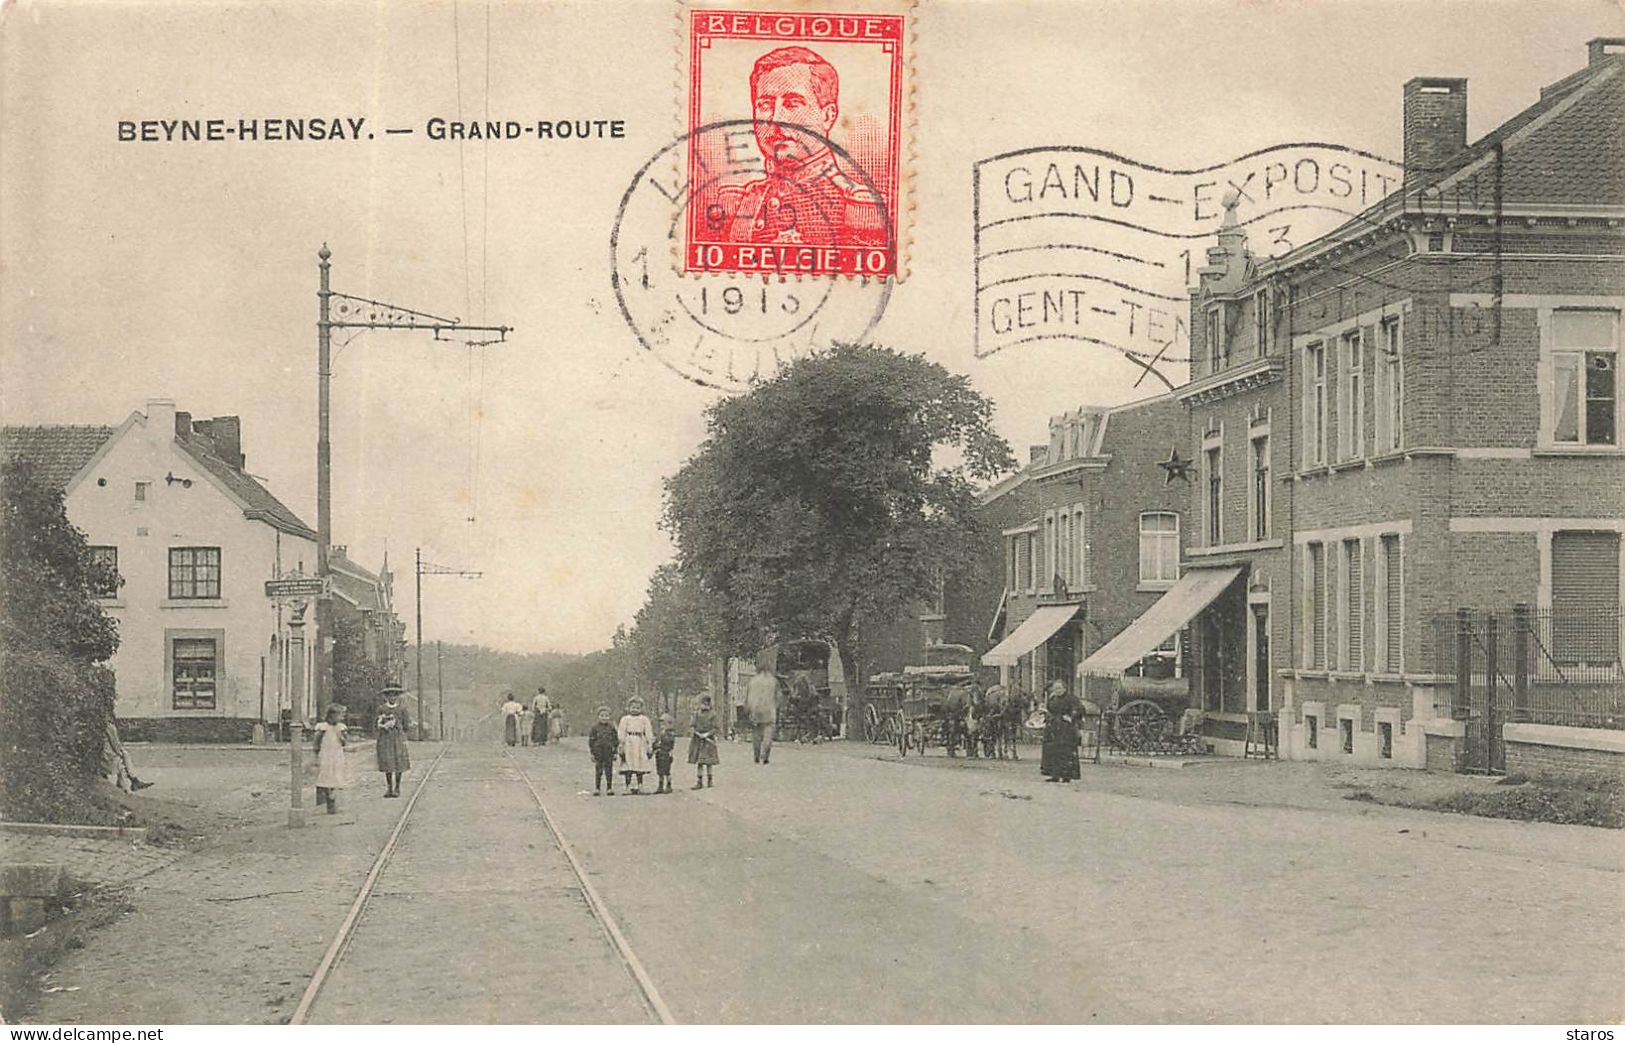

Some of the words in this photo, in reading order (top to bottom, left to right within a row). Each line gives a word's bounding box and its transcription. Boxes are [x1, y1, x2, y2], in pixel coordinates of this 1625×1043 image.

[708, 15, 883, 37] BELGIQUE
[695, 245, 724, 268] 10
[738, 246, 842, 271] BELGIE
[854, 250, 887, 273] 10
